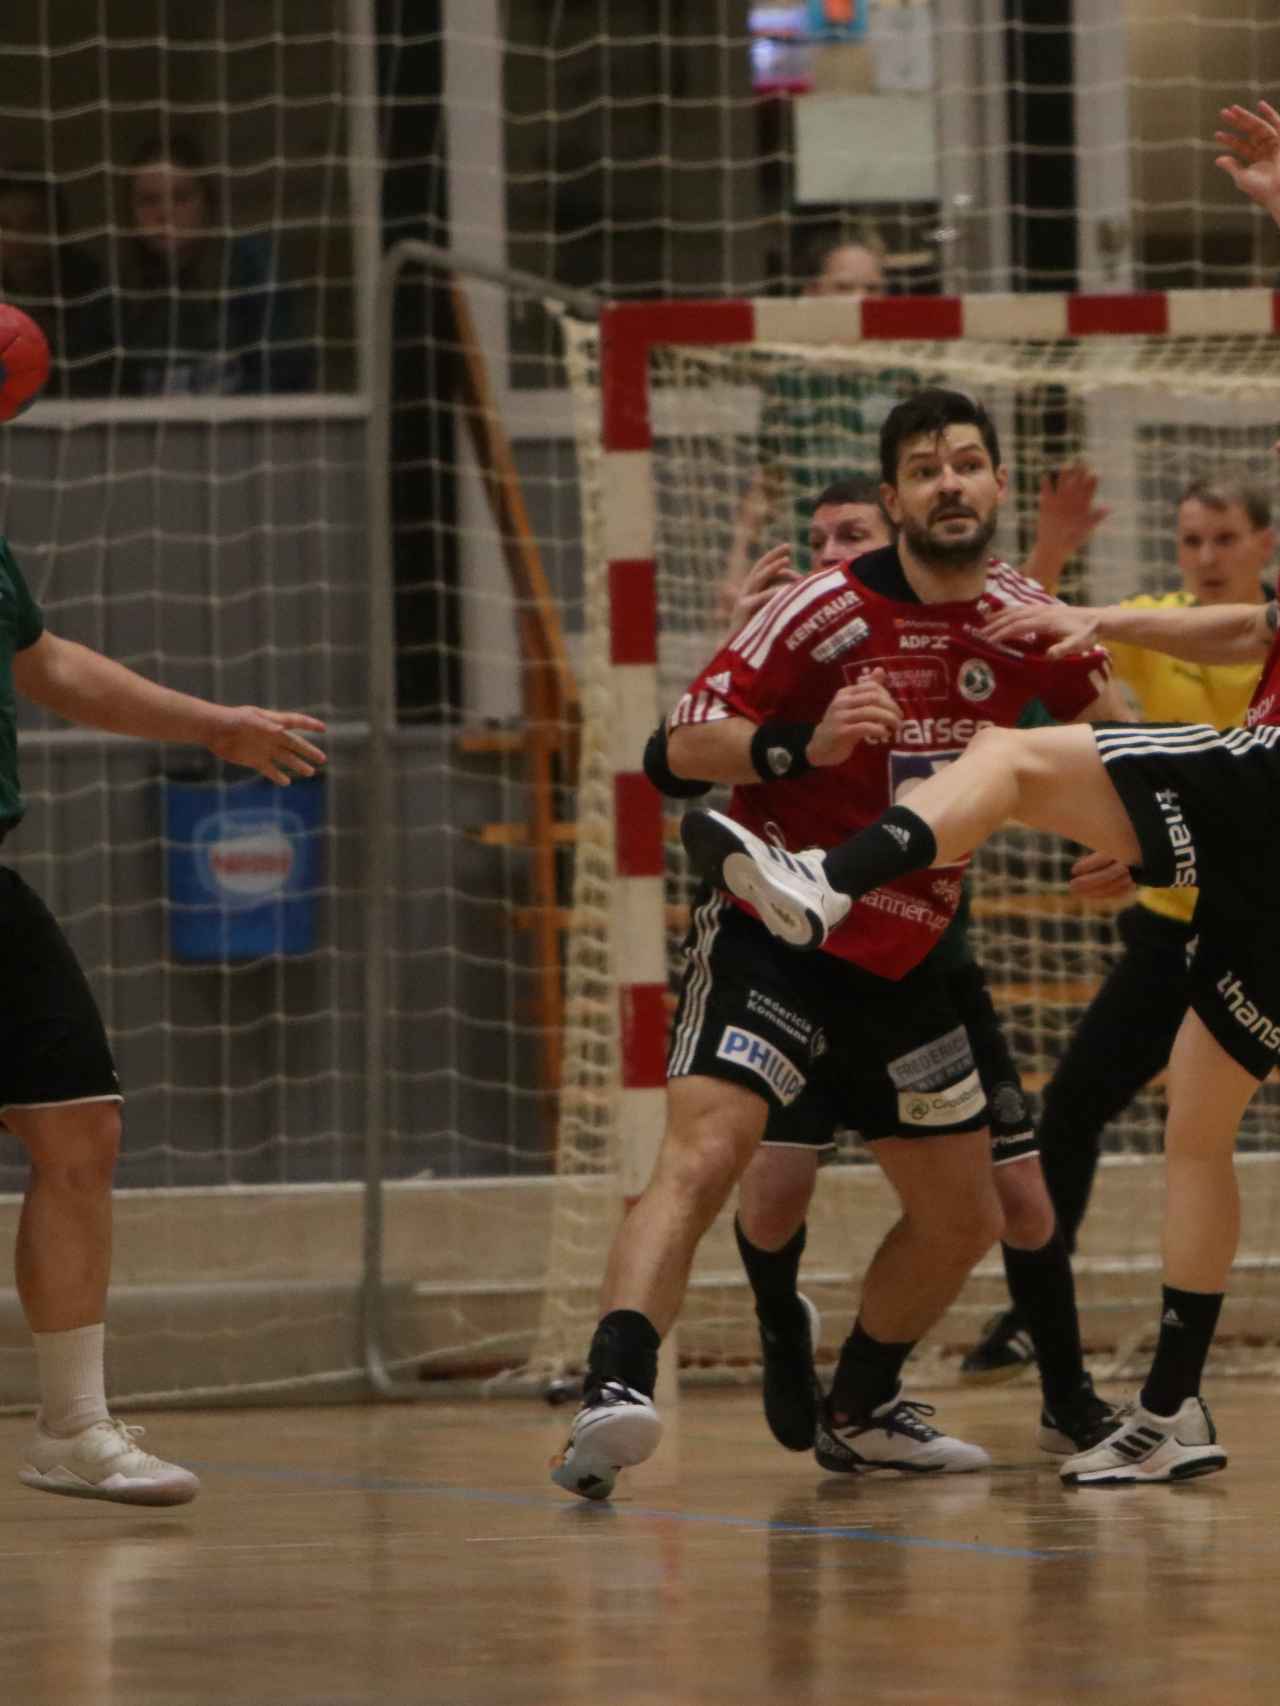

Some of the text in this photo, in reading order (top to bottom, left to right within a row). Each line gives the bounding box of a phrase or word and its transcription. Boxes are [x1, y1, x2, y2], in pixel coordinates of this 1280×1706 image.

[784, 590, 861, 651] KENTAUR
[746, 999, 809, 1045] Kommune
[749, 989, 811, 1034] Fredericia
